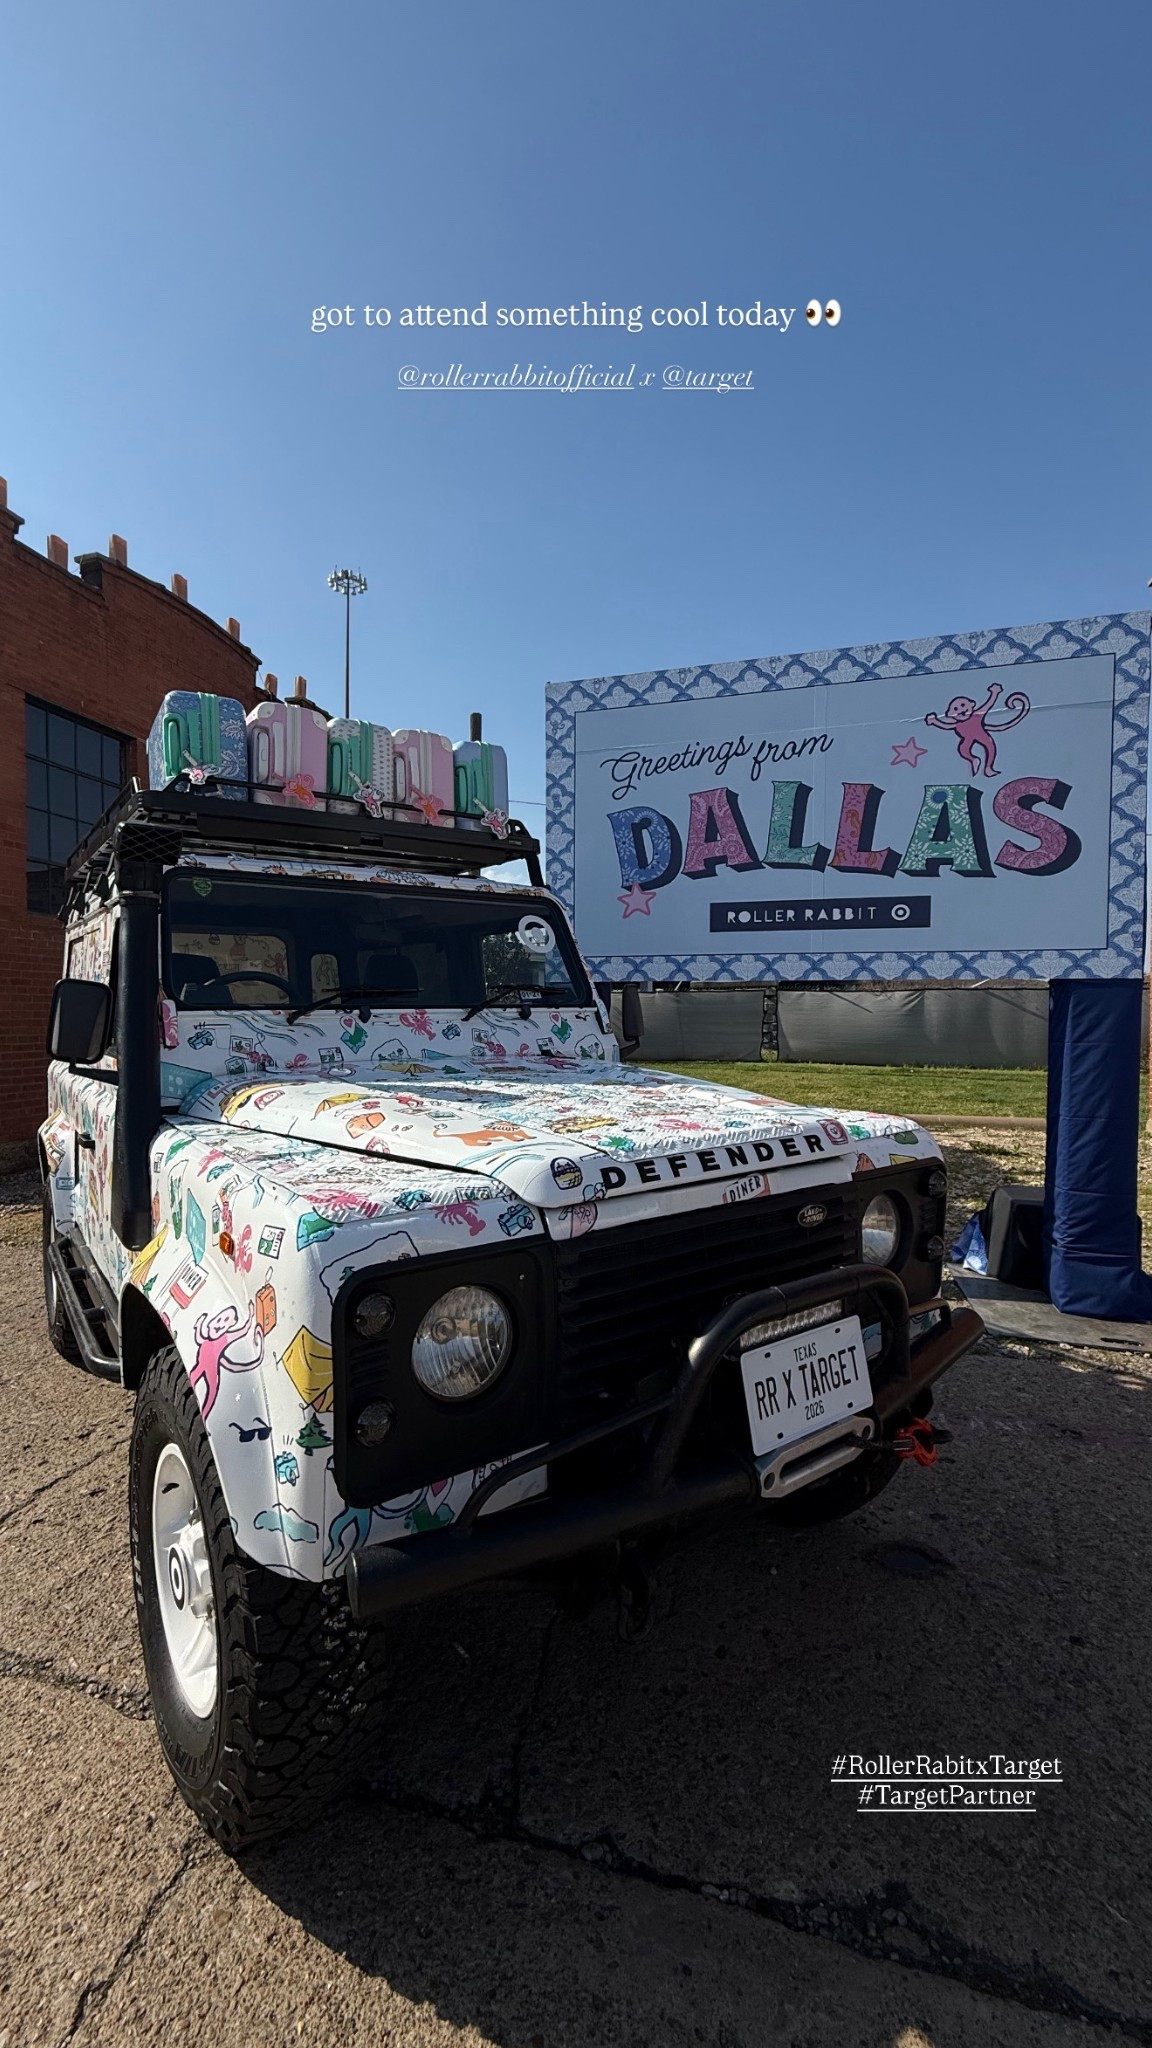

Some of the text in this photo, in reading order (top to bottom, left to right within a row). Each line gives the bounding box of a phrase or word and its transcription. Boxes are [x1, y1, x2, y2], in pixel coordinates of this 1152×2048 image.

[599, 733, 835, 800] Greetings from
[606, 776, 1083, 890] DALLAS
[727, 906, 877, 924] ROLLER RABBIT
[601, 1133, 826, 1190] DEFENDER
[728, 1174, 762, 1202] DINER
[793, 1342, 818, 1363] TEXAS
[754, 1345, 860, 1421] RR X TARGET
[804, 1400, 825, 1421] 2026
